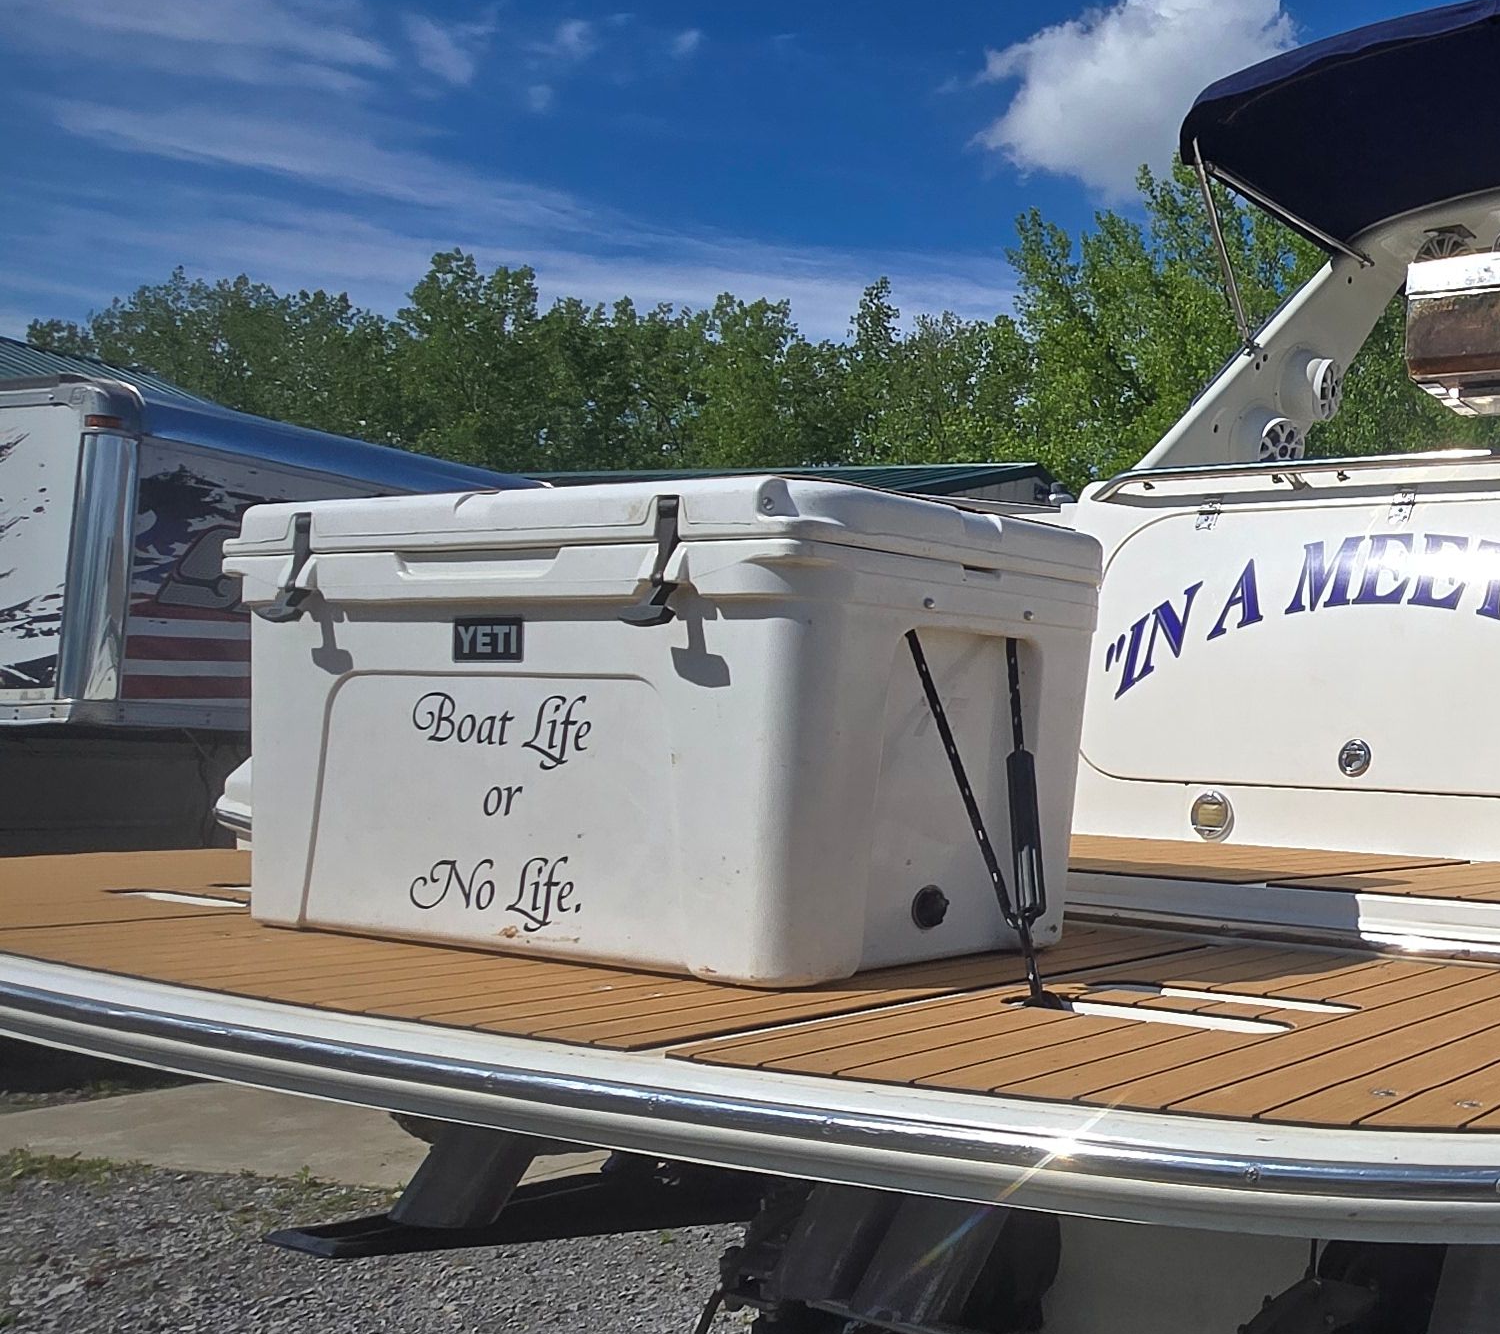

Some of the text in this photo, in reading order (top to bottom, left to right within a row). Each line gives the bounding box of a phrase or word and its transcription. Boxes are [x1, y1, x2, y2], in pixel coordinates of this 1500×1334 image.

[457, 625, 518, 654] YETI
[1104, 579, 1203, 701] "IN
[1207, 558, 1263, 642] A
[412, 692, 592, 771] Boat Life
[483, 785, 523, 817] or
[409, 856, 582, 933] No Life.
